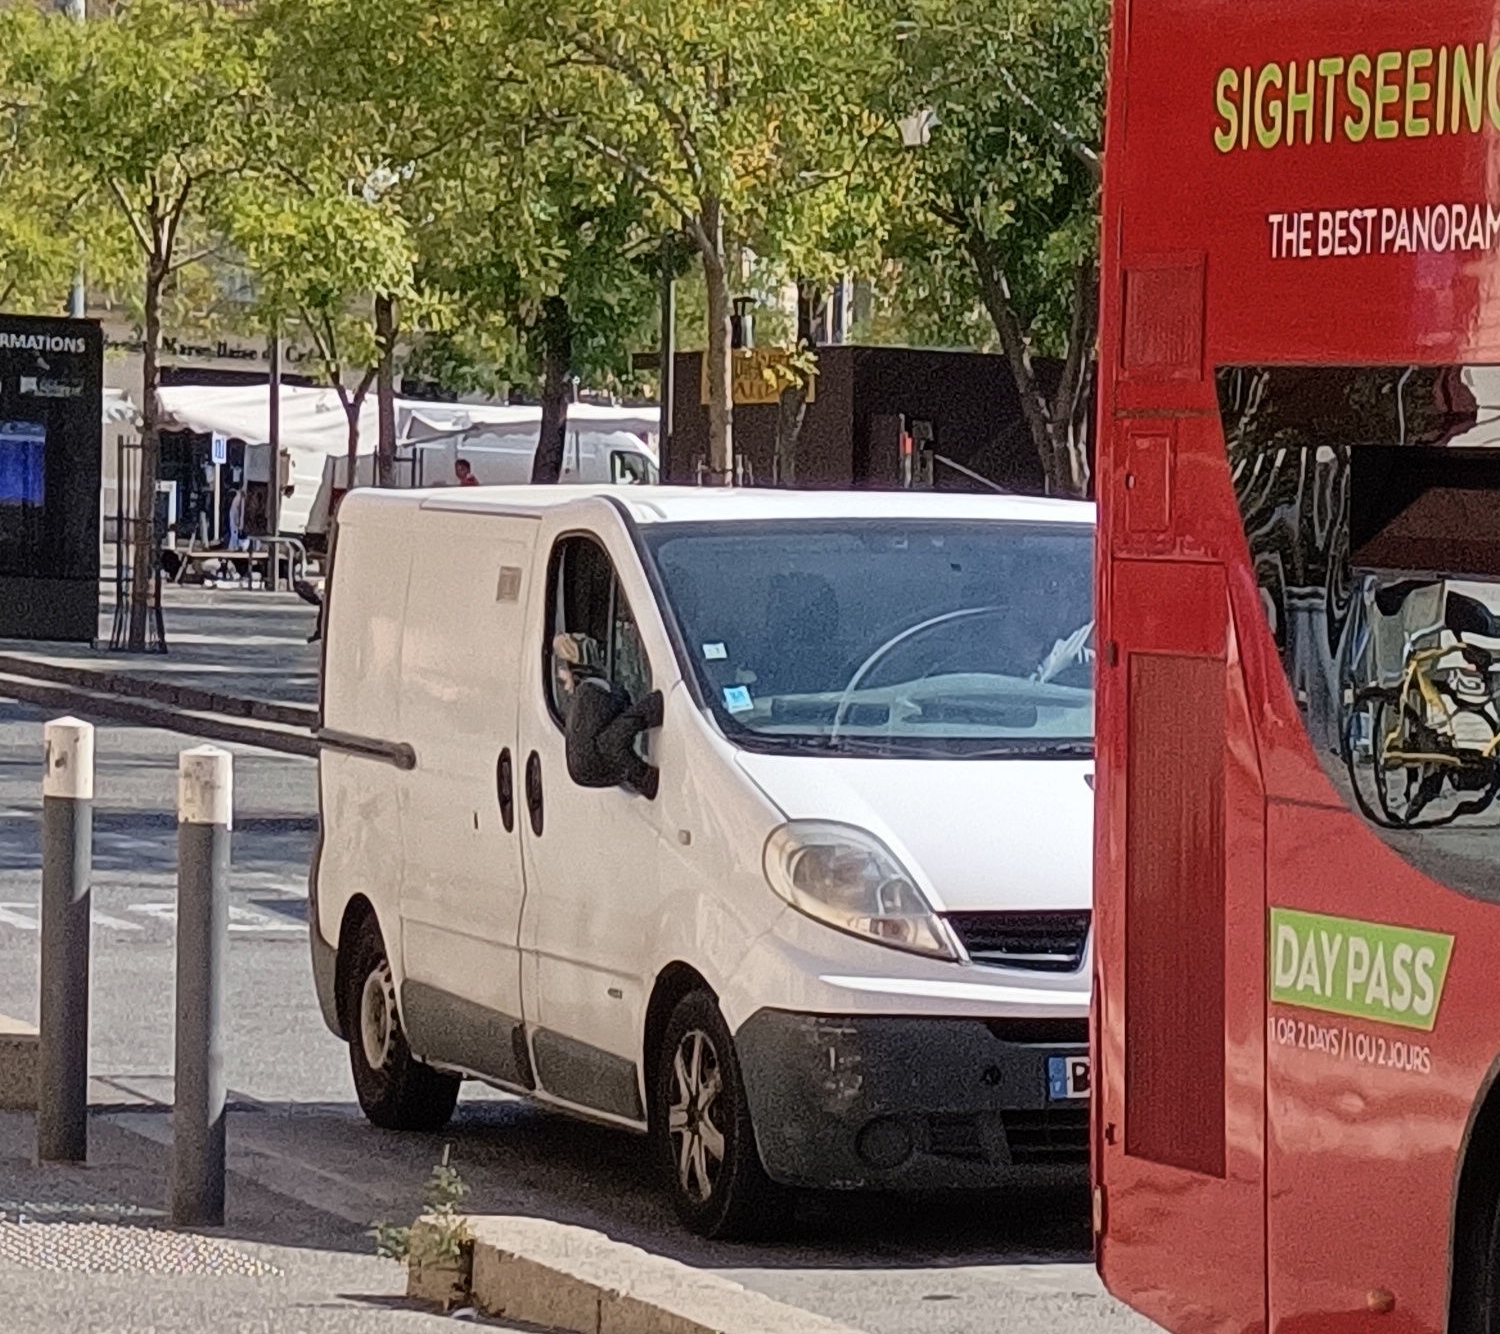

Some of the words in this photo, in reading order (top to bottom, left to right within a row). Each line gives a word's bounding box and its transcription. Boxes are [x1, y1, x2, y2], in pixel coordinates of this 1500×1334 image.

[1268, 212, 1313, 259] THE
[1317, 207, 1377, 257] BEST
[1274, 923, 1343, 998] DAY
[1345, 936, 1436, 1017] PASS
[1269, 1017, 1276, 1042] 1
[1277, 1017, 1296, 1046] OR
[1298, 1022, 1307, 1049] 2
[1307, 1024, 1340, 1057] DAYS
[1355, 1033, 1376, 1063] OU
[1377, 1037, 1387, 1066] 2
[1387, 1041, 1432, 1074] JOURS
